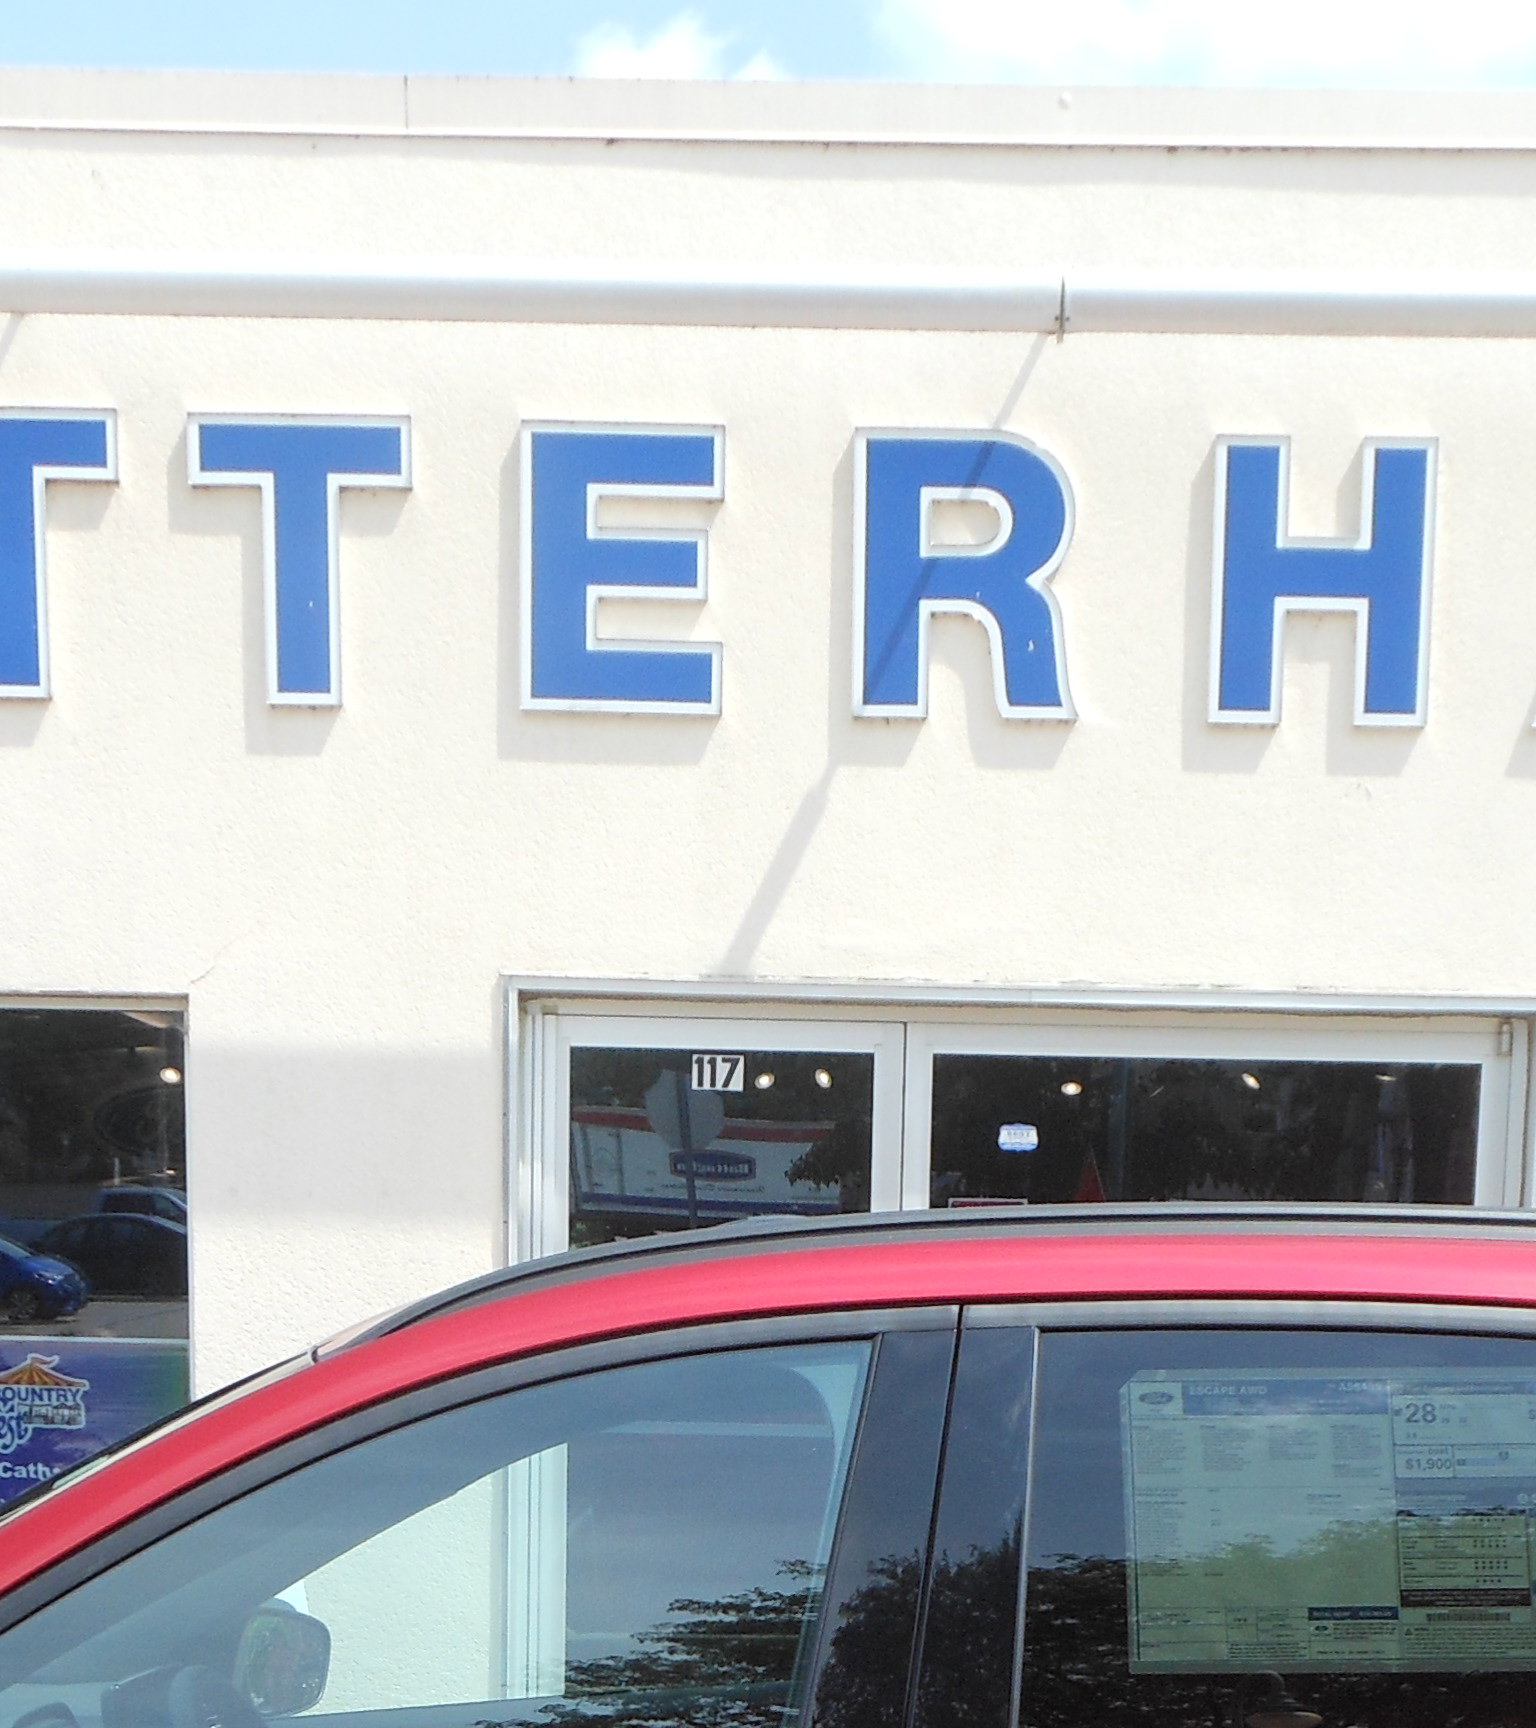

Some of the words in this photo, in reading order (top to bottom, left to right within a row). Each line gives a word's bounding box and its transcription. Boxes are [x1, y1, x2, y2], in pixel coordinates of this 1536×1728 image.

[695, 1056, 740, 1088] 117
[1404, 1402, 1437, 1424] 28
[1404, 1458, 1452, 1471] $1,900
